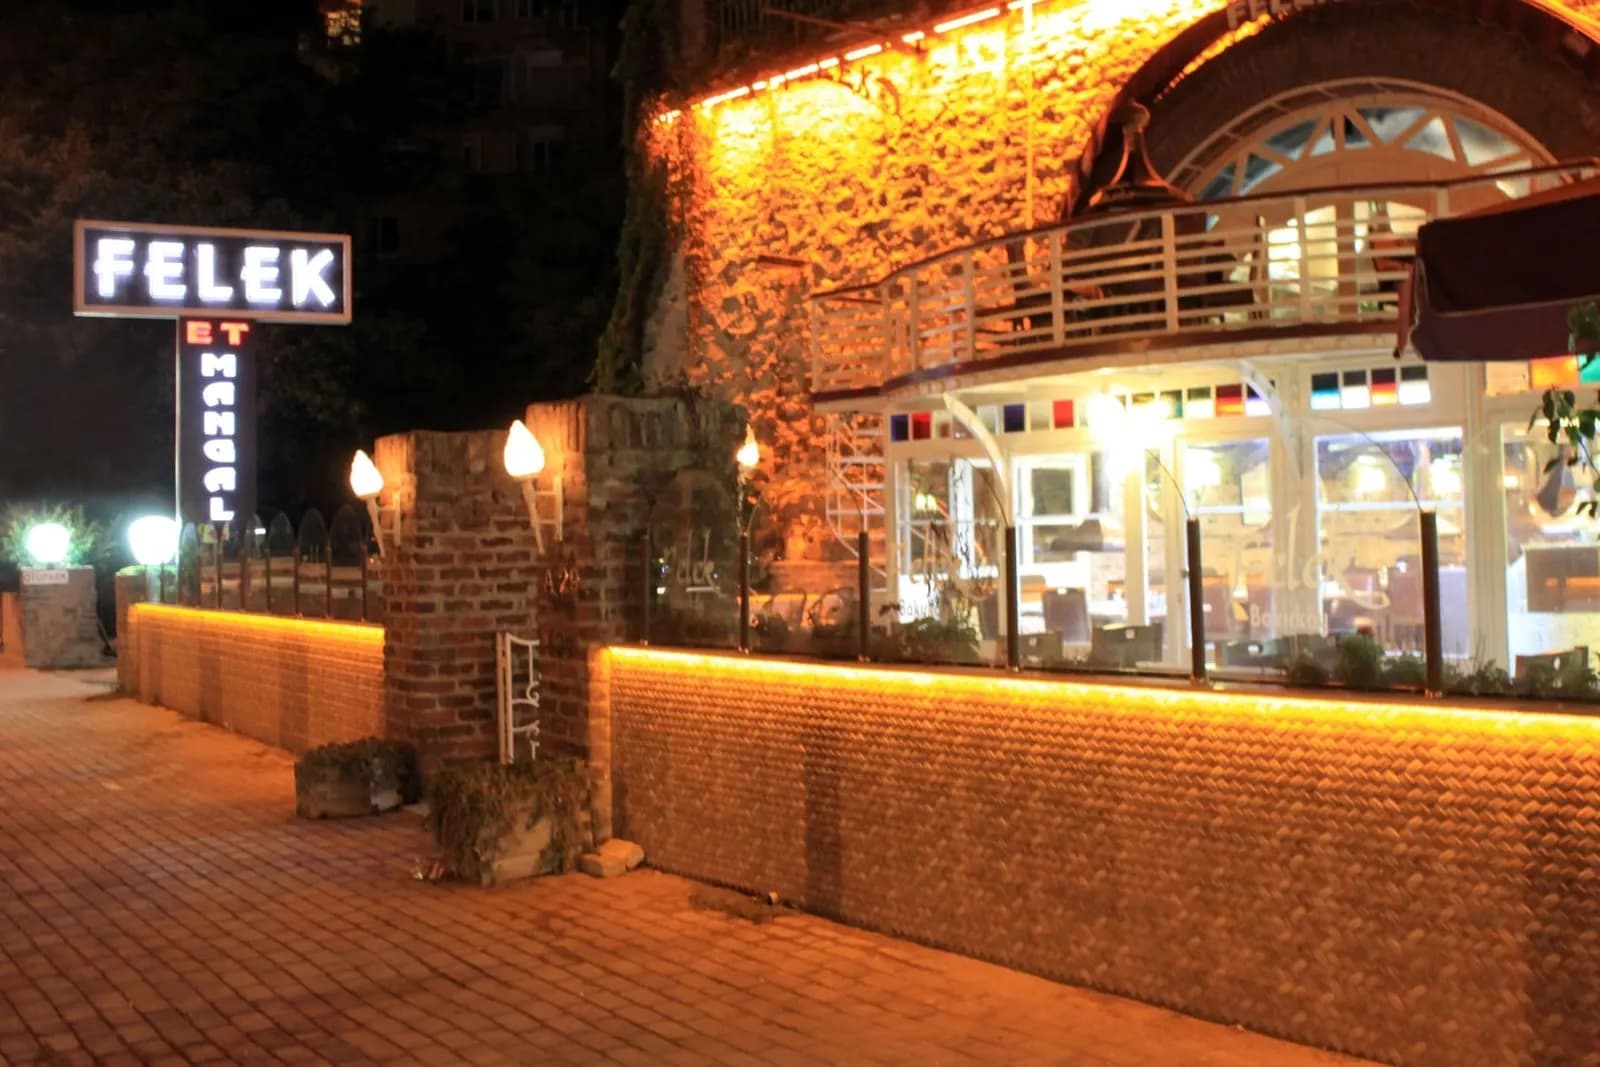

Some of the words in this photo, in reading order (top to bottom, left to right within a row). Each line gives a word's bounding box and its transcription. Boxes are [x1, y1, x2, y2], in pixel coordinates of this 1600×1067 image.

[95, 238, 336, 307] FELEK
[186, 320, 250, 346] ET
[200, 352, 238, 522] MANGAL
